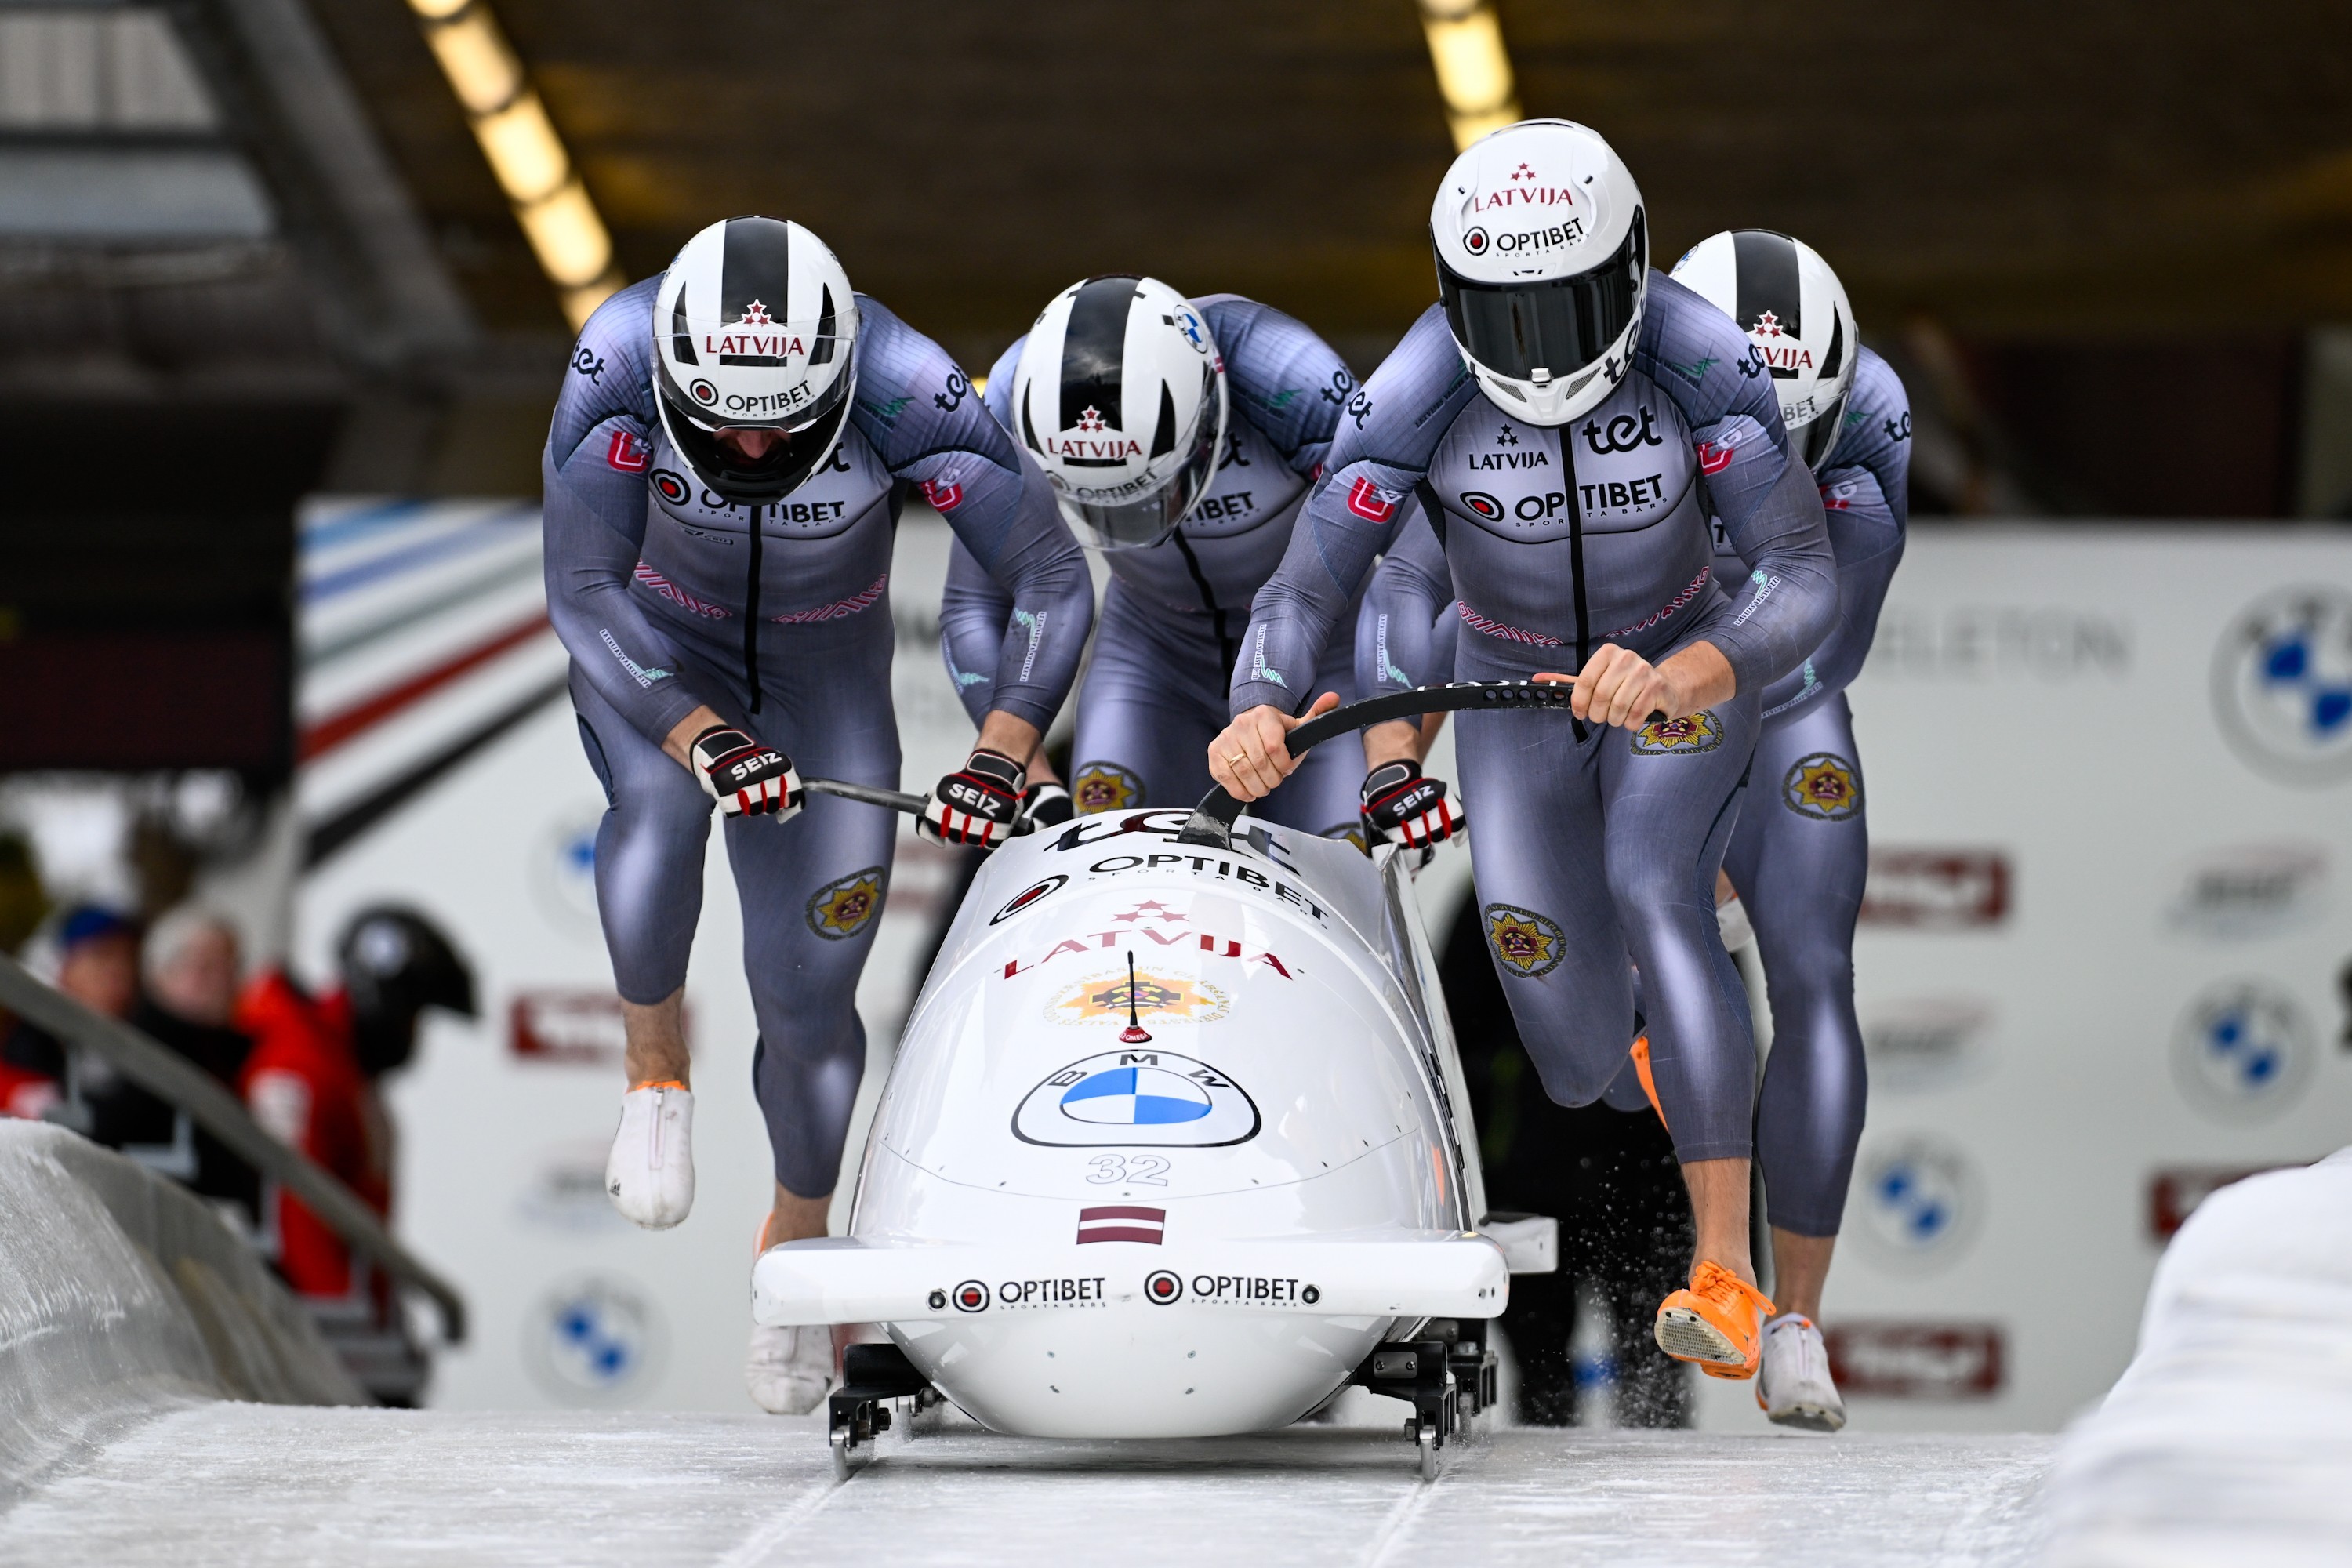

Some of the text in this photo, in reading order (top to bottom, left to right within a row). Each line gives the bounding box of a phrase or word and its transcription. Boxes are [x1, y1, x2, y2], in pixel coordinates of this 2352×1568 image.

[1475, 187, 1573, 213] LATVIJA
[1497, 216, 1584, 251] OPTIBET
[1496, 249, 1551, 257] SPORTA
[706, 335, 804, 358] LATVIJA
[1756, 346, 1813, 368] VIJA
[725, 380, 812, 412] OPTIBET
[724, 408, 777, 418] SPORTA
[1582, 405, 1663, 455] tet
[1047, 437, 1142, 459] LATVIJA
[1469, 451, 1549, 470] LATVIJA
[1076, 467, 1159, 500] OPTIBET
[1515, 473, 1663, 521] OPTIBET
[698, 508, 789, 527] SPORTA
[1515, 497, 1668, 528] SPORTA BĀRS
[1087, 869, 1225, 881] SPORTA
[1089, 854, 1329, 920] OPTIBET
[1004, 929, 1293, 981] LATVIJA
[1125, 1033, 1149, 1042] OMEGA
[1047, 1054, 1231, 1088] BMW
[1085, 1153, 1171, 1187] 32
[999, 1277, 1105, 1303] OPTIBET
[1192, 1274, 1298, 1301] OPTIBET
[1191, 1298, 1250, 1306] SPORTA
